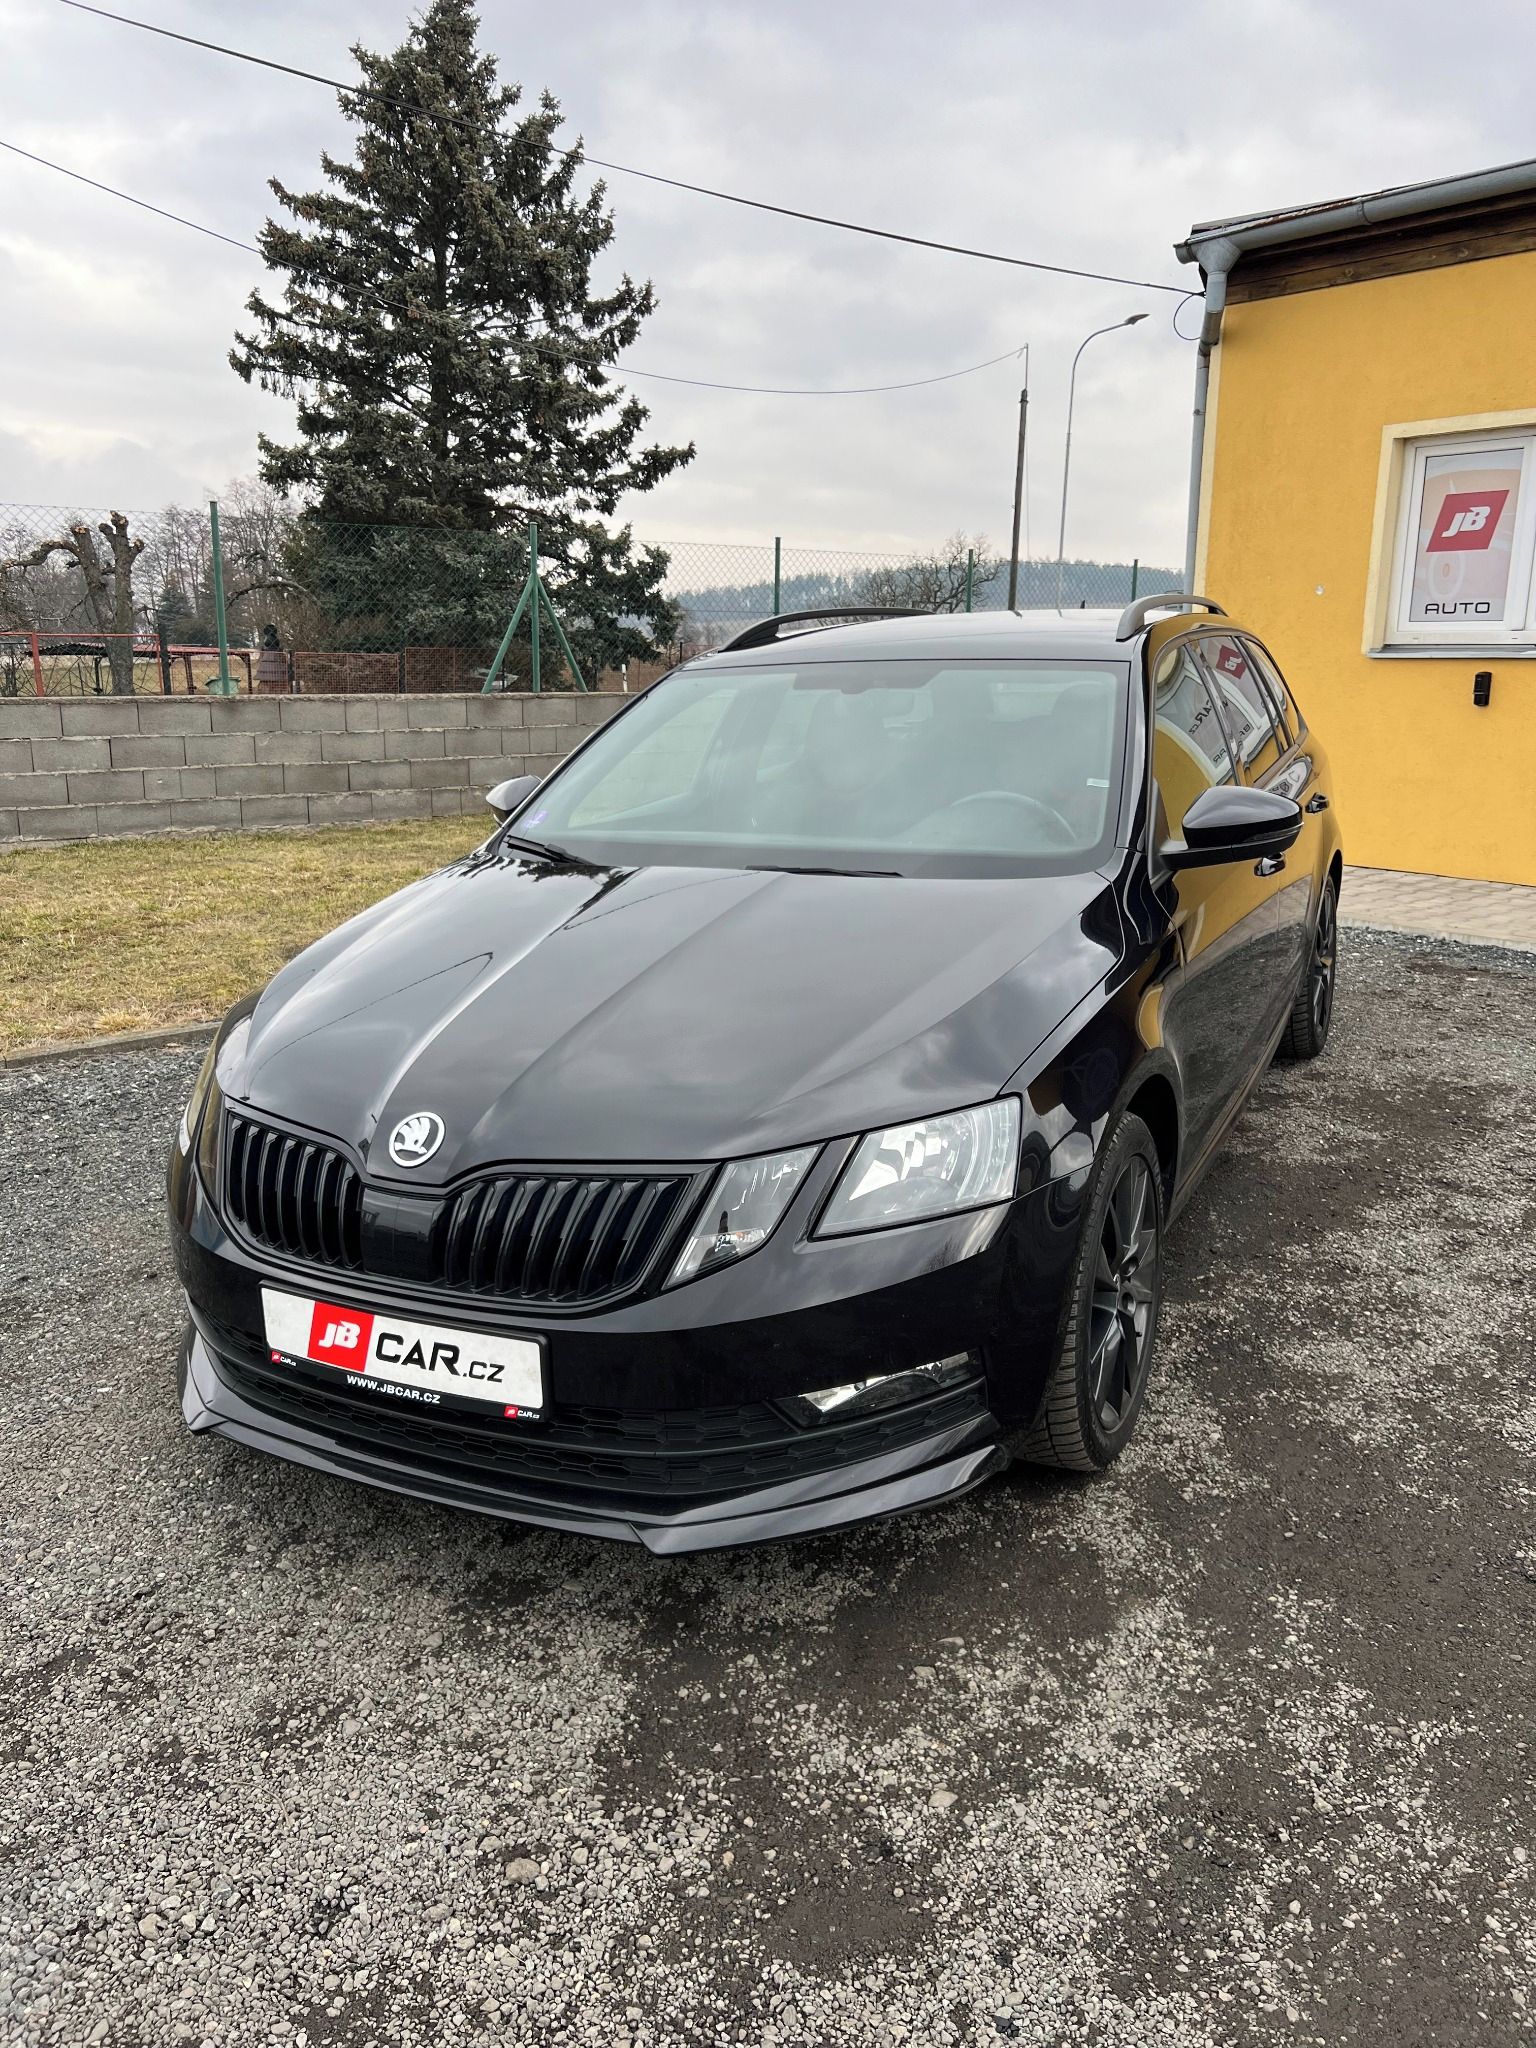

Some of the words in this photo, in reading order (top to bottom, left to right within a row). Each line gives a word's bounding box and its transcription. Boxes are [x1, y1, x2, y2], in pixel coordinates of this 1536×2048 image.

[1441, 506, 1491, 538] JB
[1424, 602, 1491, 615] AUTO
[318, 1320, 361, 1349] JB
